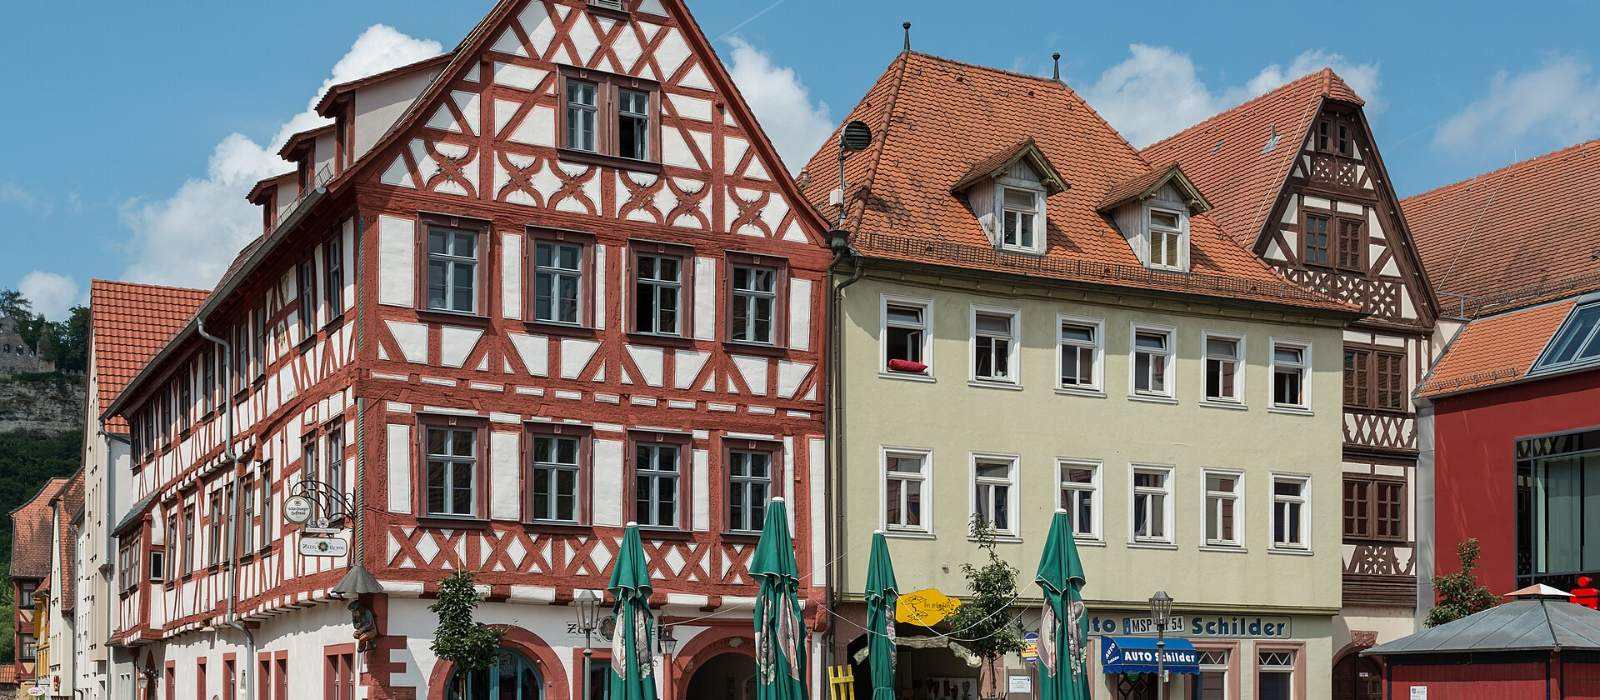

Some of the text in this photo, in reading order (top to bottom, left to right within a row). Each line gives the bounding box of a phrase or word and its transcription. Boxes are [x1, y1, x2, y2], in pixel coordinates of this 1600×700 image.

[1088, 616, 1117, 633] to
[1132, 618, 1153, 632] MSP
[1171, 617, 1183, 631] 54
[1191, 616, 1287, 636] Schilder
[1124, 651, 1153, 662] AUTO
